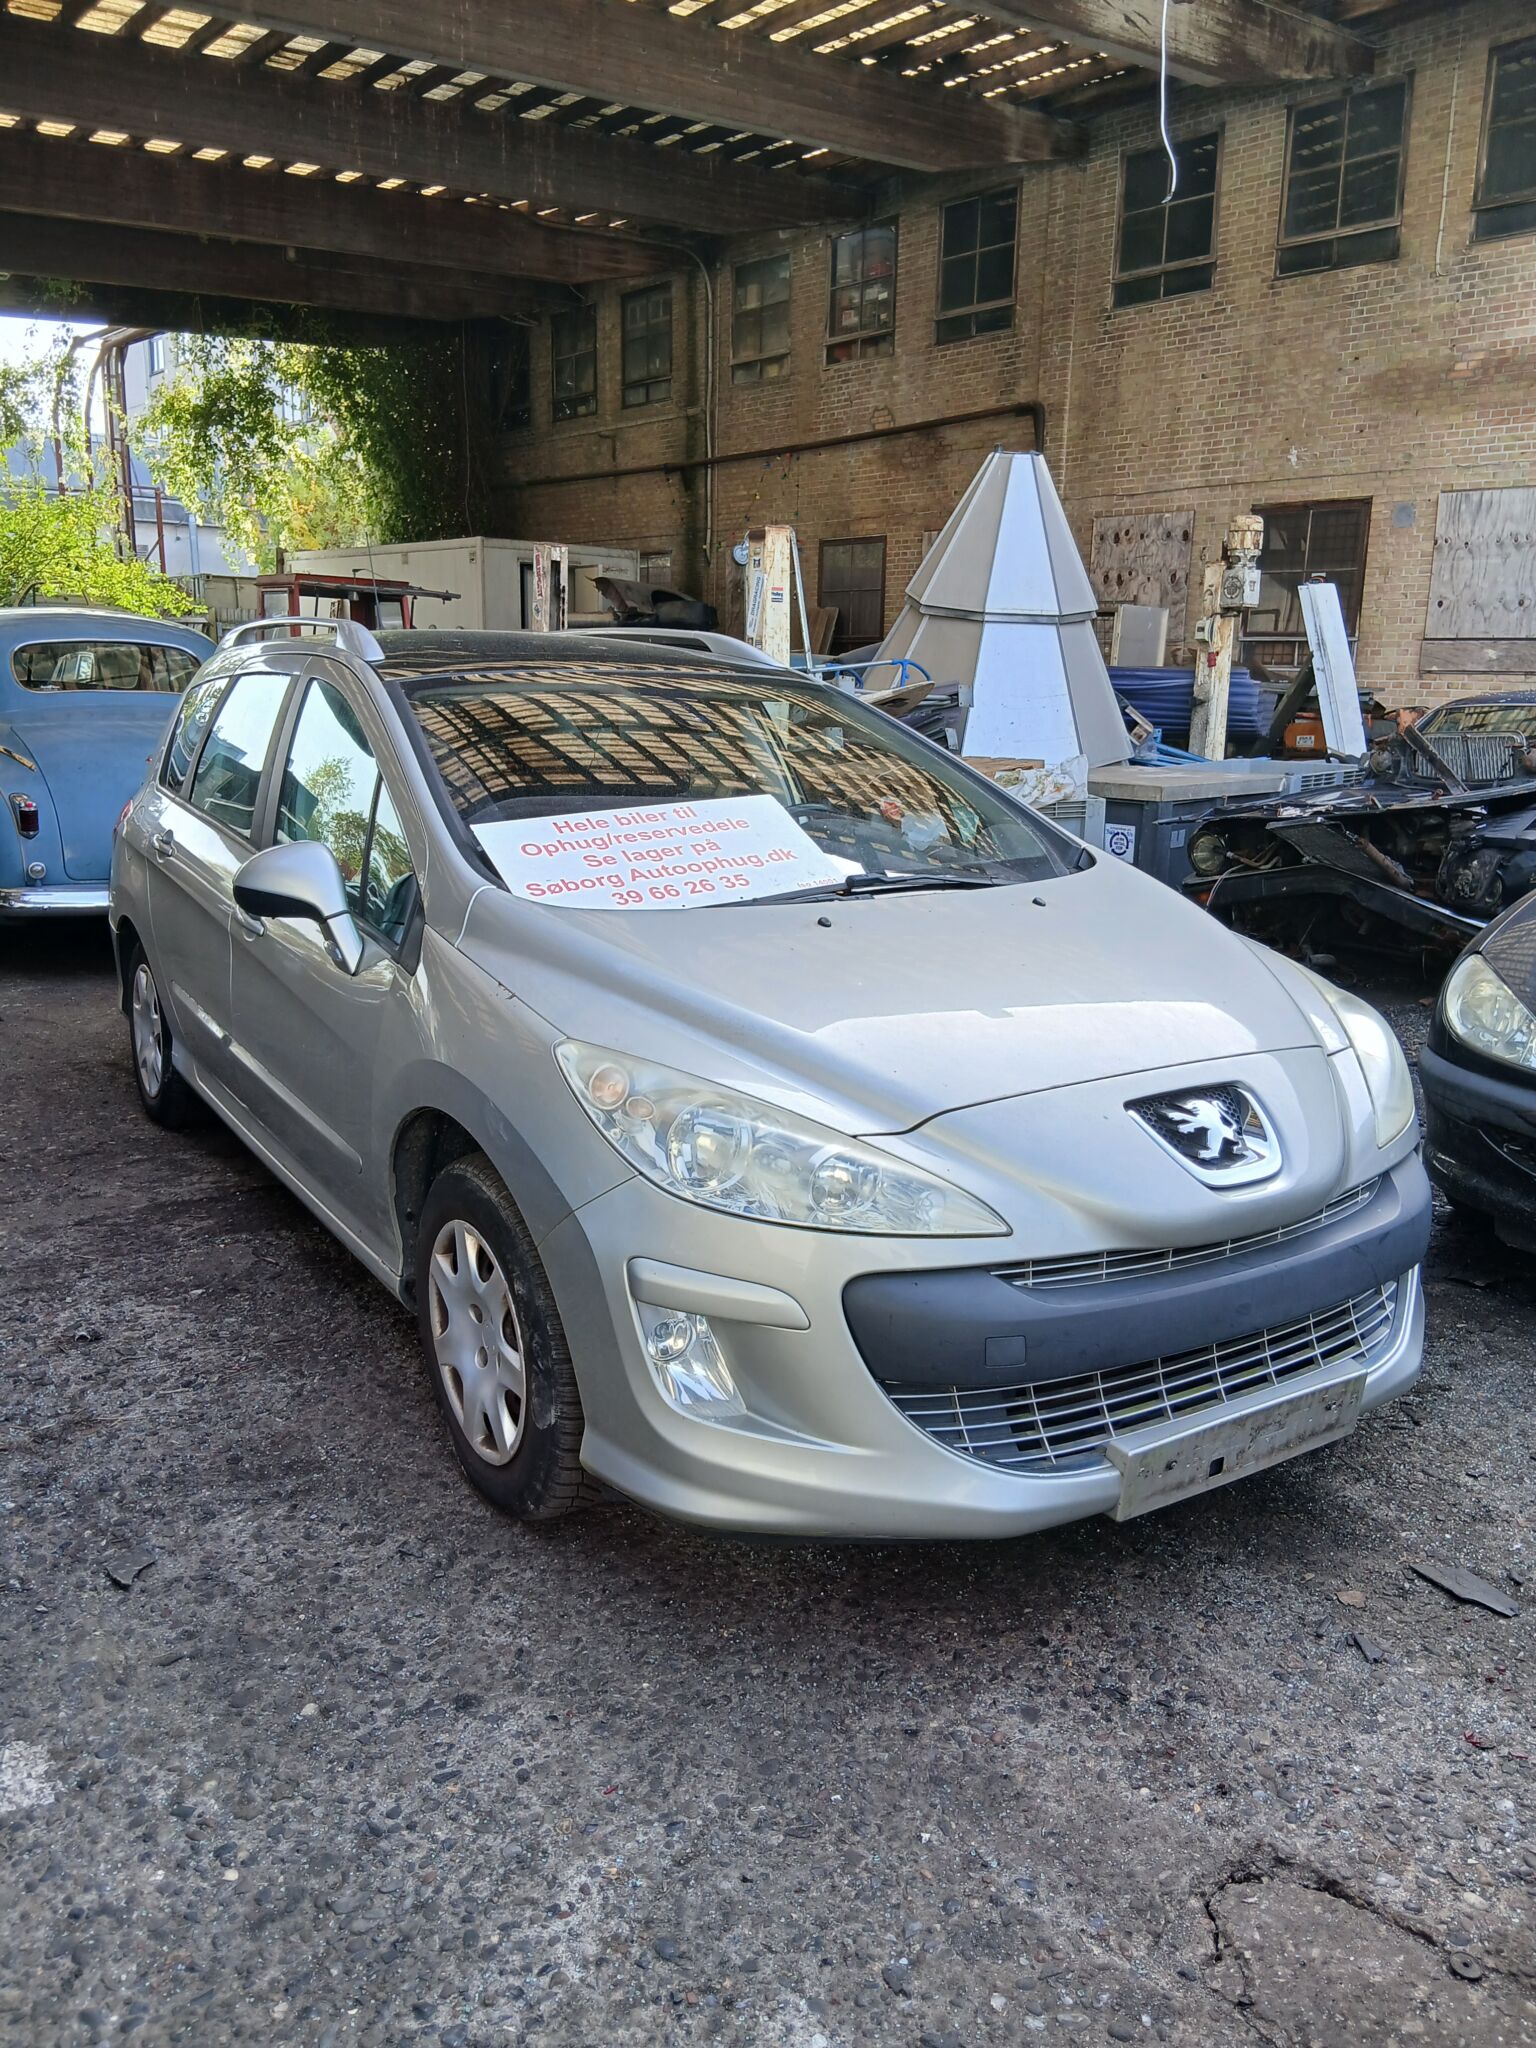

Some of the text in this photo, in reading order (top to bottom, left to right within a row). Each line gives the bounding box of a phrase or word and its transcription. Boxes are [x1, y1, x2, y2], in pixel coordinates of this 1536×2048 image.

[552, 806, 697, 834] Hele biler til
[520, 817, 750, 857] Ophug/reservedele
[583, 838, 722, 868] Se lager på
[526, 848, 798, 897] Søborg Autoophug.dk
[611, 873, 751, 906] 39 66 26 35
